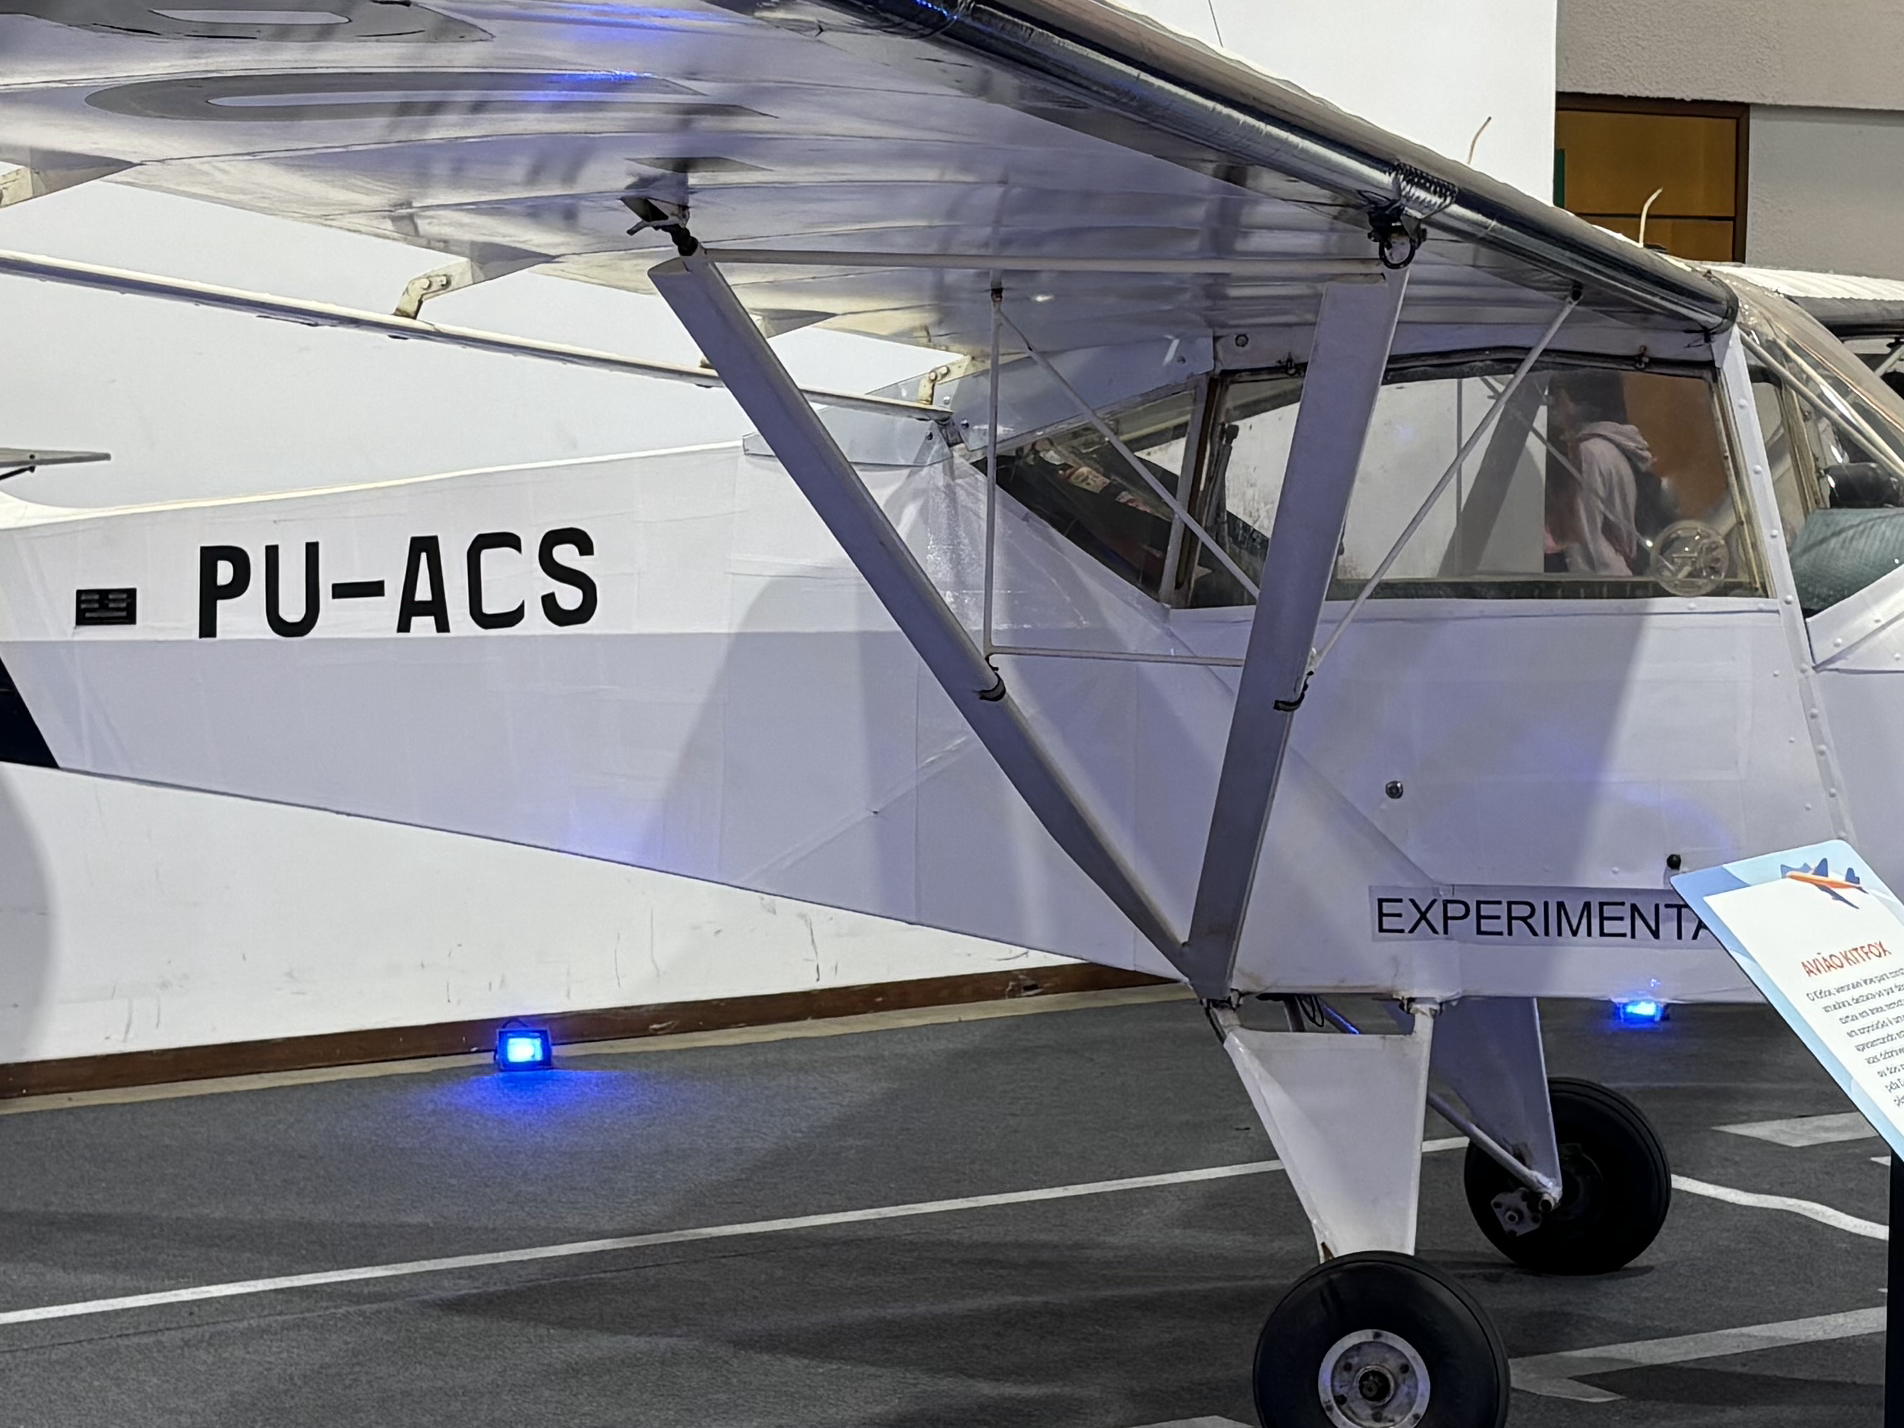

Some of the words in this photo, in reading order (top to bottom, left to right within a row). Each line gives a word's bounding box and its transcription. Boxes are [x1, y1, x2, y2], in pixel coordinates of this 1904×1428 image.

[198, 527, 597, 638] PU-ACS
[1801, 952, 1844, 977] AVIÃO
[1839, 941, 1892, 966] KITFOX
